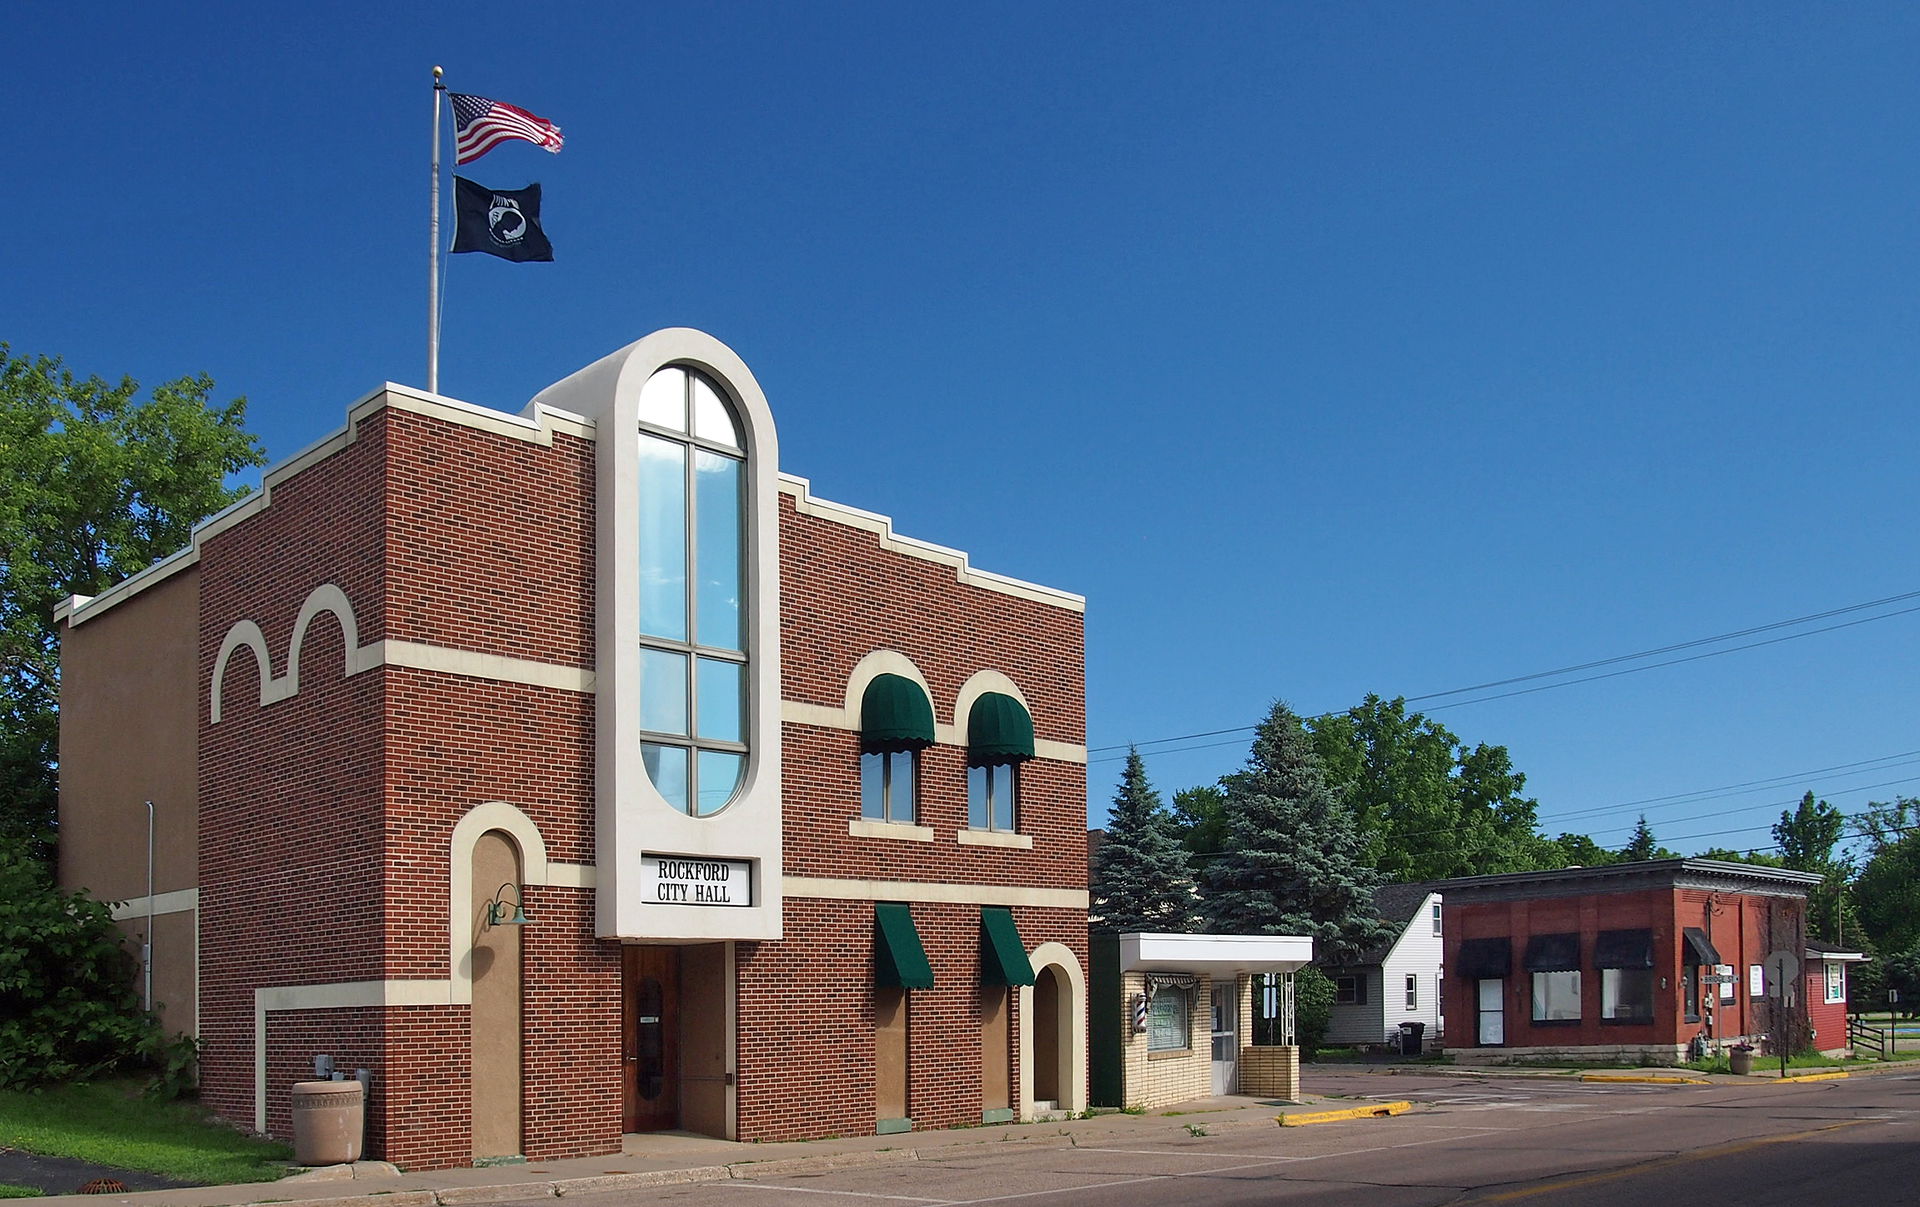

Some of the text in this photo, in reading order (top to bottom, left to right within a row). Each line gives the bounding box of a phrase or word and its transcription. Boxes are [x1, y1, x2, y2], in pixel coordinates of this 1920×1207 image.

[658, 860, 729, 881] ROCKFORD
[658, 883, 730, 902] CITY HALL
[1704, 975, 1726, 983] BRIDGE
